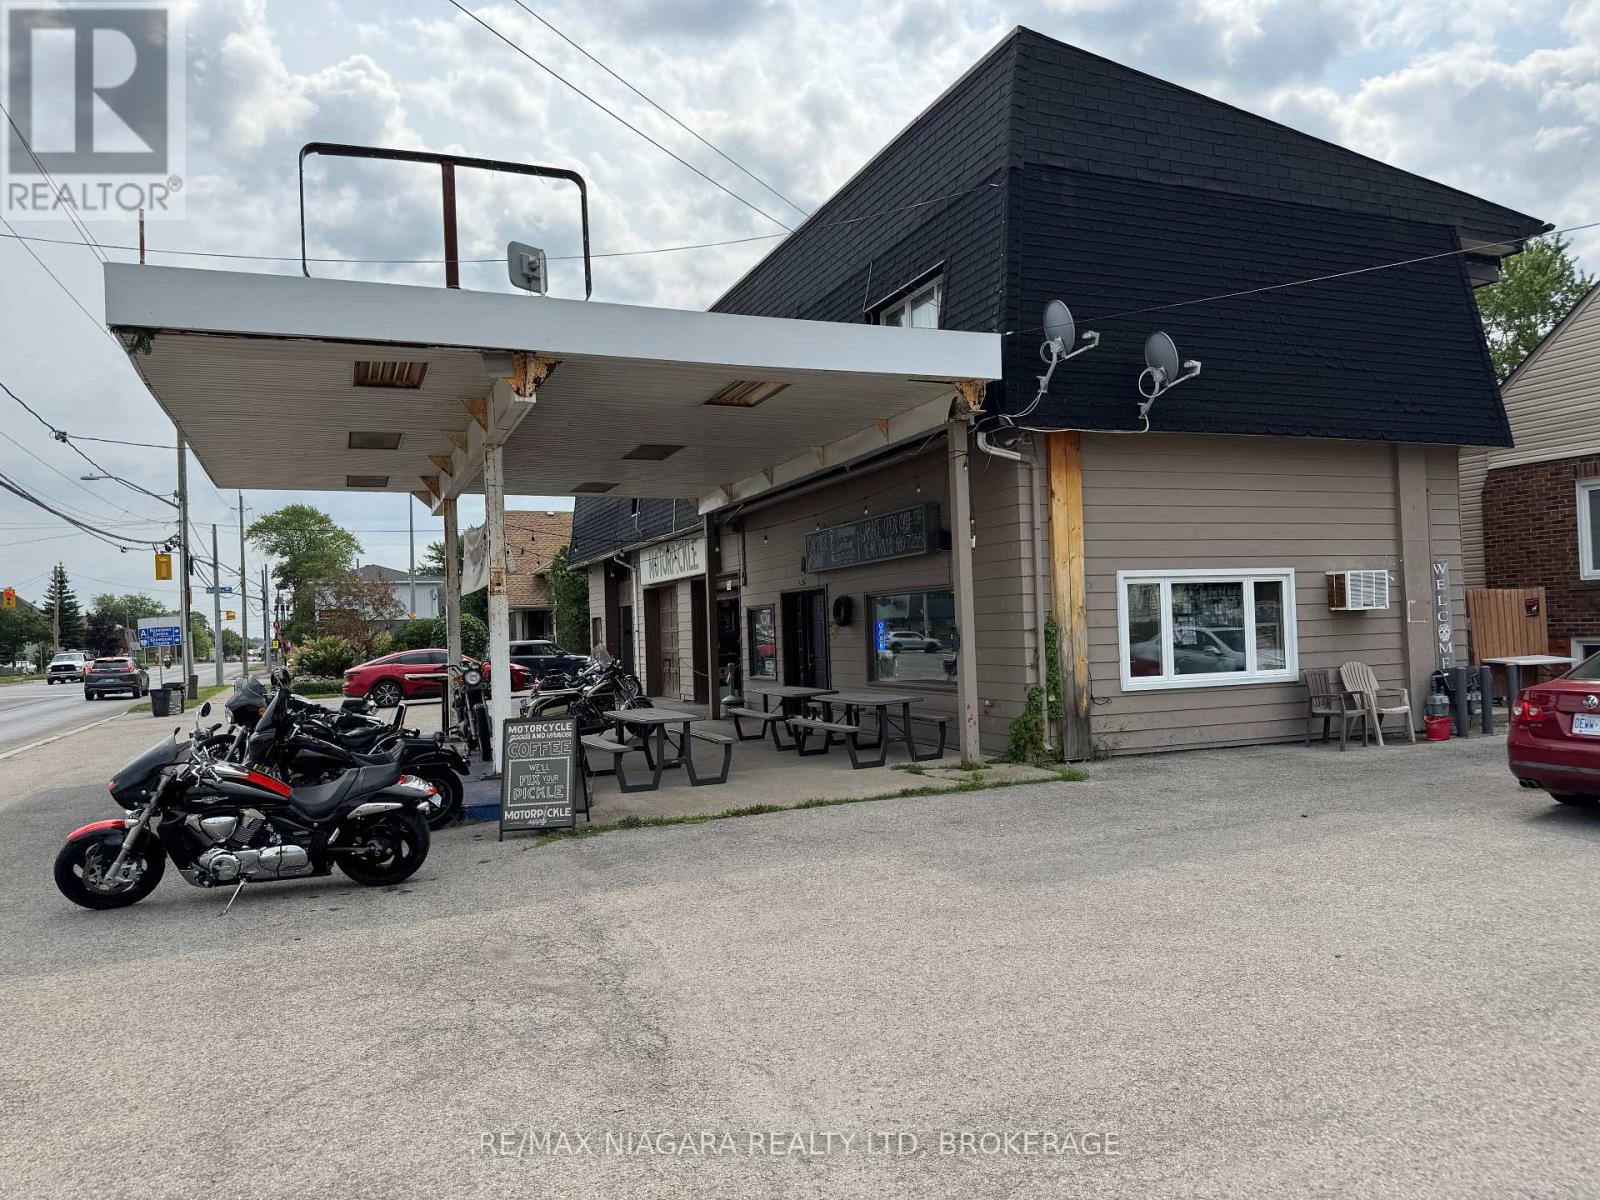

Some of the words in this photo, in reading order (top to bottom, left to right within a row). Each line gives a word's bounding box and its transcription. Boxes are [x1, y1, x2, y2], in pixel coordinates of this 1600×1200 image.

[508, 722, 572, 734] MOTORCYCLE
[531, 732, 545, 740] AND
[507, 739, 572, 758] COFFEE
[519, 774, 541, 786] FIX
[513, 785, 564, 800] PICKLE
